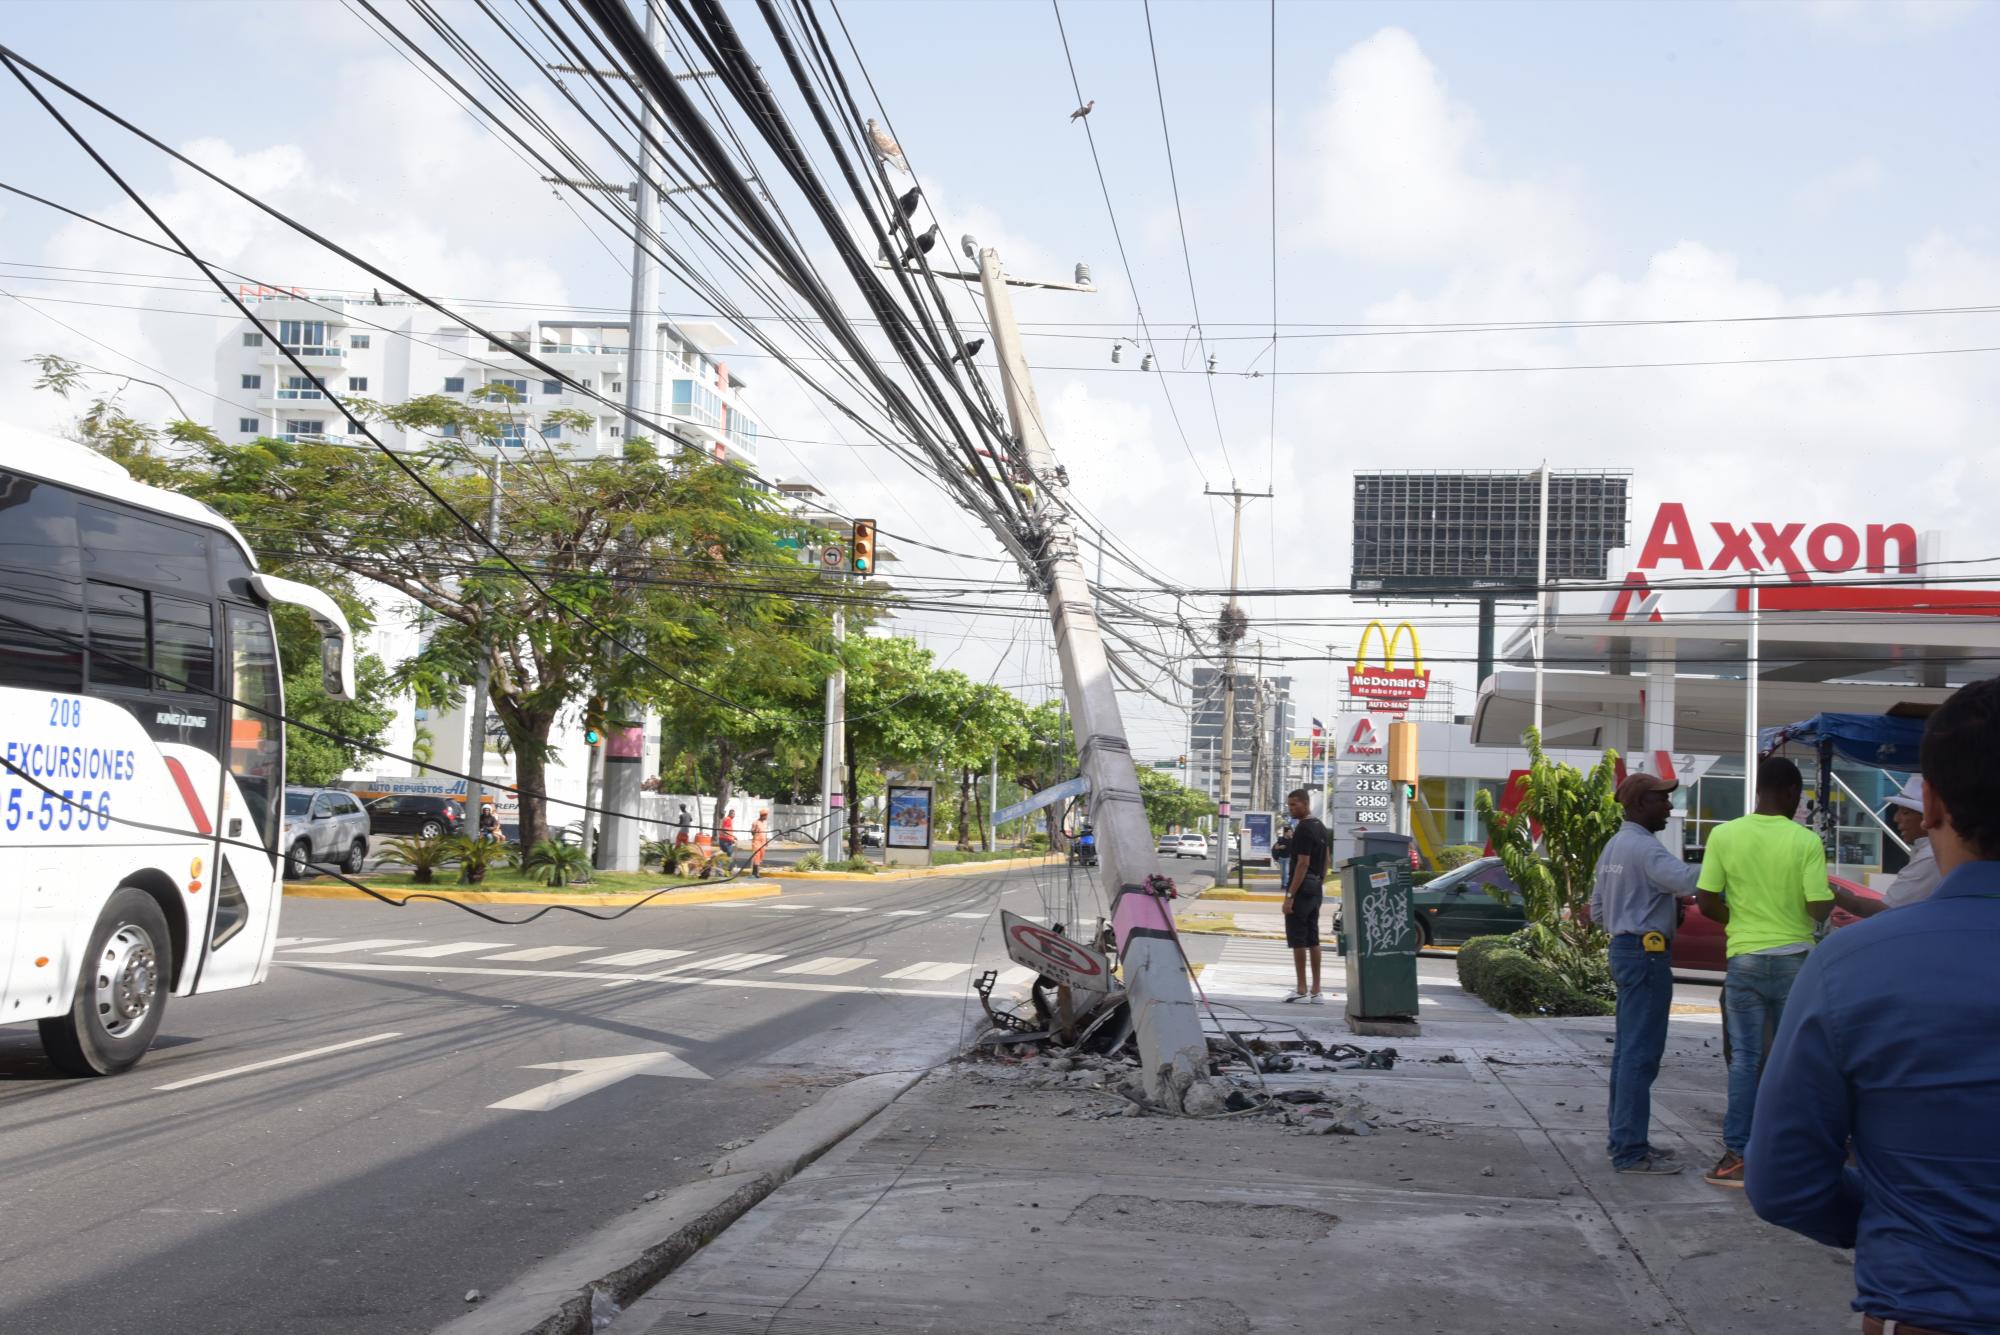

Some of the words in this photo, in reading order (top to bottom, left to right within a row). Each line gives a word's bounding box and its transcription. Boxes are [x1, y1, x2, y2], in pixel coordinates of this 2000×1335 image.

[1637, 502, 1918, 587] Axxon
[1352, 675, 1426, 688] McDonald's
[49, 697, 81, 728] 208
[6, 742, 135, 781] EXCURSIONES
[1347, 745, 1382, 756] Axxon
[368, 783, 391, 792] AUTO
[393, 784, 443, 794] REPUESTOS
[0, 788, 112, 831] 5-5556
